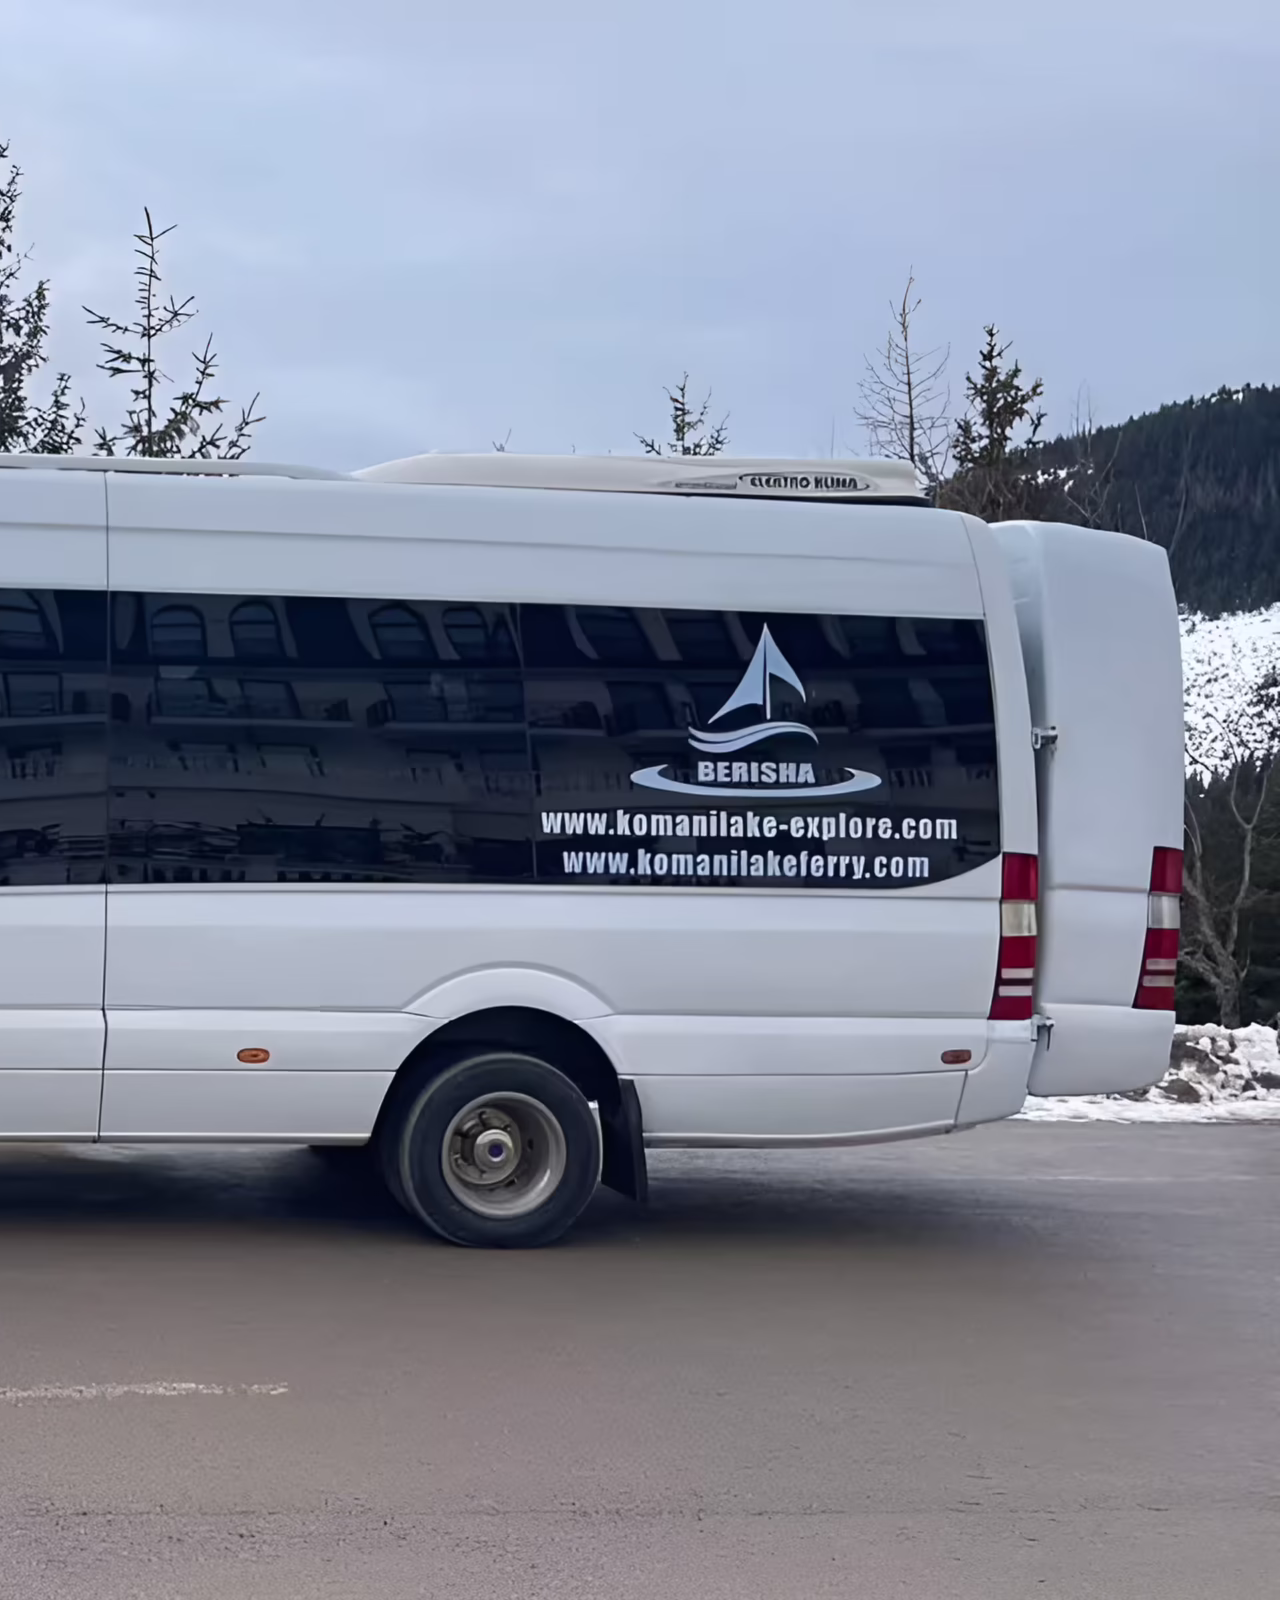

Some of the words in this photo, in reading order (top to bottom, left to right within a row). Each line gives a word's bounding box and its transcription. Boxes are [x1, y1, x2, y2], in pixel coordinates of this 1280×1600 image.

[697, 761, 816, 784] BERISHA
[541, 809, 958, 841] www.komanilake-explore.com
[563, 848, 929, 879] www.komanilakeferry.com
